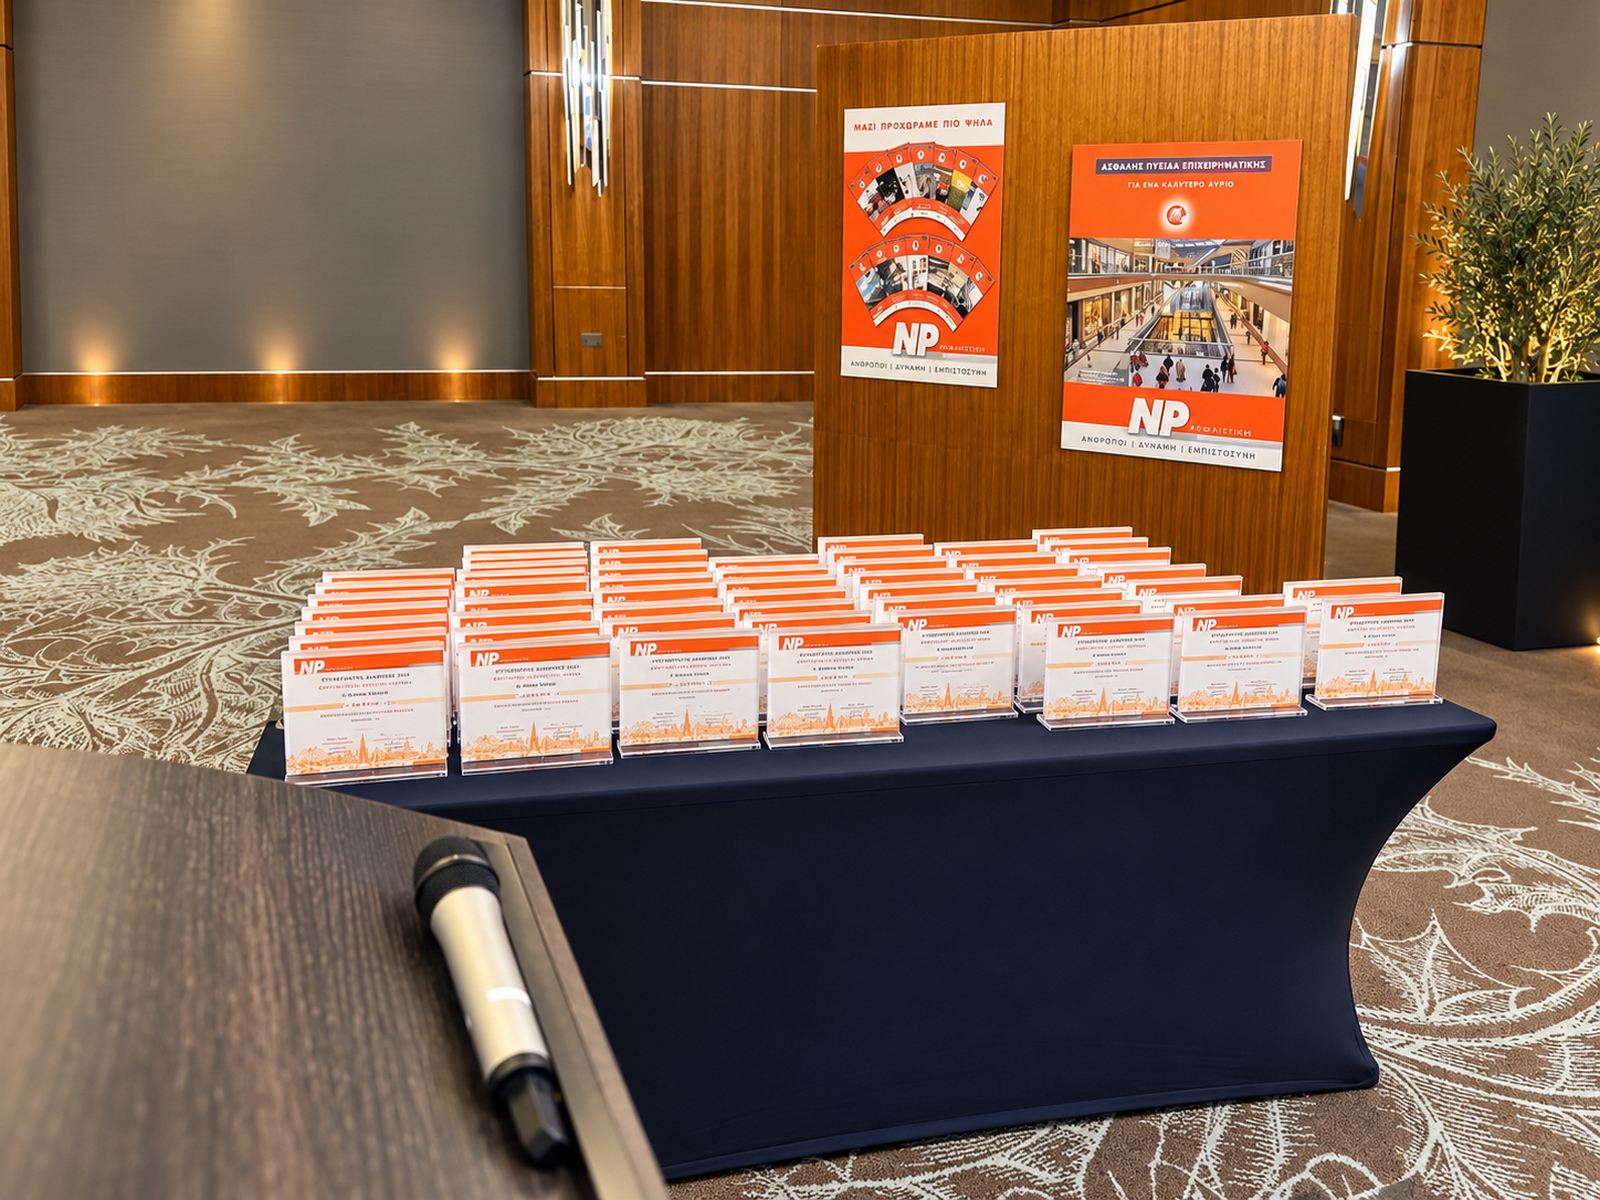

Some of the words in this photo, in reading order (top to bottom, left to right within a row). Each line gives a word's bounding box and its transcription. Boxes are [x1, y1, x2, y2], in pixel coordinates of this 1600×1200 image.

[853, 122, 876, 131] ΜΑΖΙ
[880, 120, 938, 131] ΠΡΟΧΩΡΑΜΕ
[943, 119, 960, 128] ΠΙΟ
[965, 118, 993, 127] ΨΗΛΑ
[1208, 180, 1234, 188] ΑΥΡΙΟ
[892, 321, 940, 356] NP
[1127, 397, 1190, 437] NP
[1335, 606, 1355, 619] NP
[908, 618, 928, 631] NP
[1196, 618, 1216, 632] NP
[1061, 626, 1082, 638] NP
[634, 642, 658, 657] NP
[782, 637, 804, 651] NP
[475, 652, 500, 666] NP
[300, 660, 326, 676] NP
